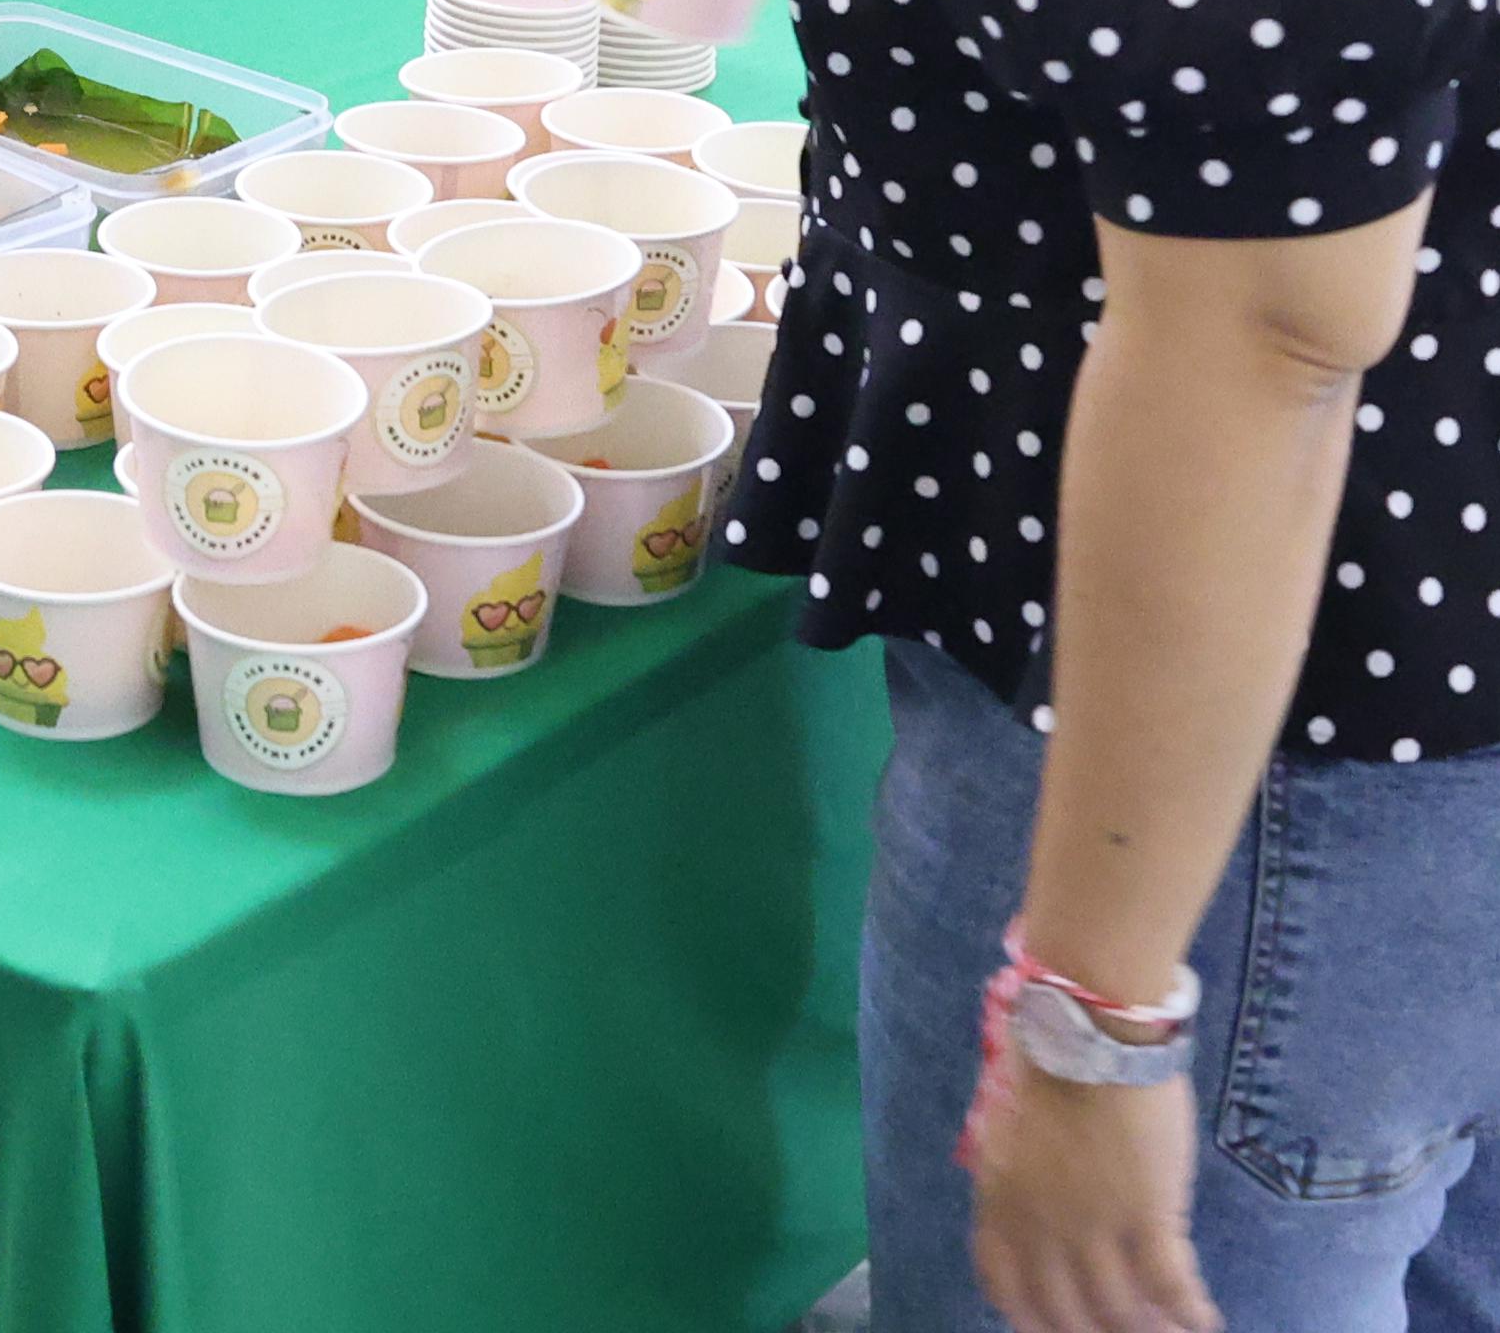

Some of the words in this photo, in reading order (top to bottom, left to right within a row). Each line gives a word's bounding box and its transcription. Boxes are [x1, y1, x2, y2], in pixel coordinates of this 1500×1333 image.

[212, 458, 261, 481] CREAM
[174, 502, 228, 551] HEALTHY
[272, 663, 323, 687] CREAM
[235, 712, 290, 761] HEALTHY
